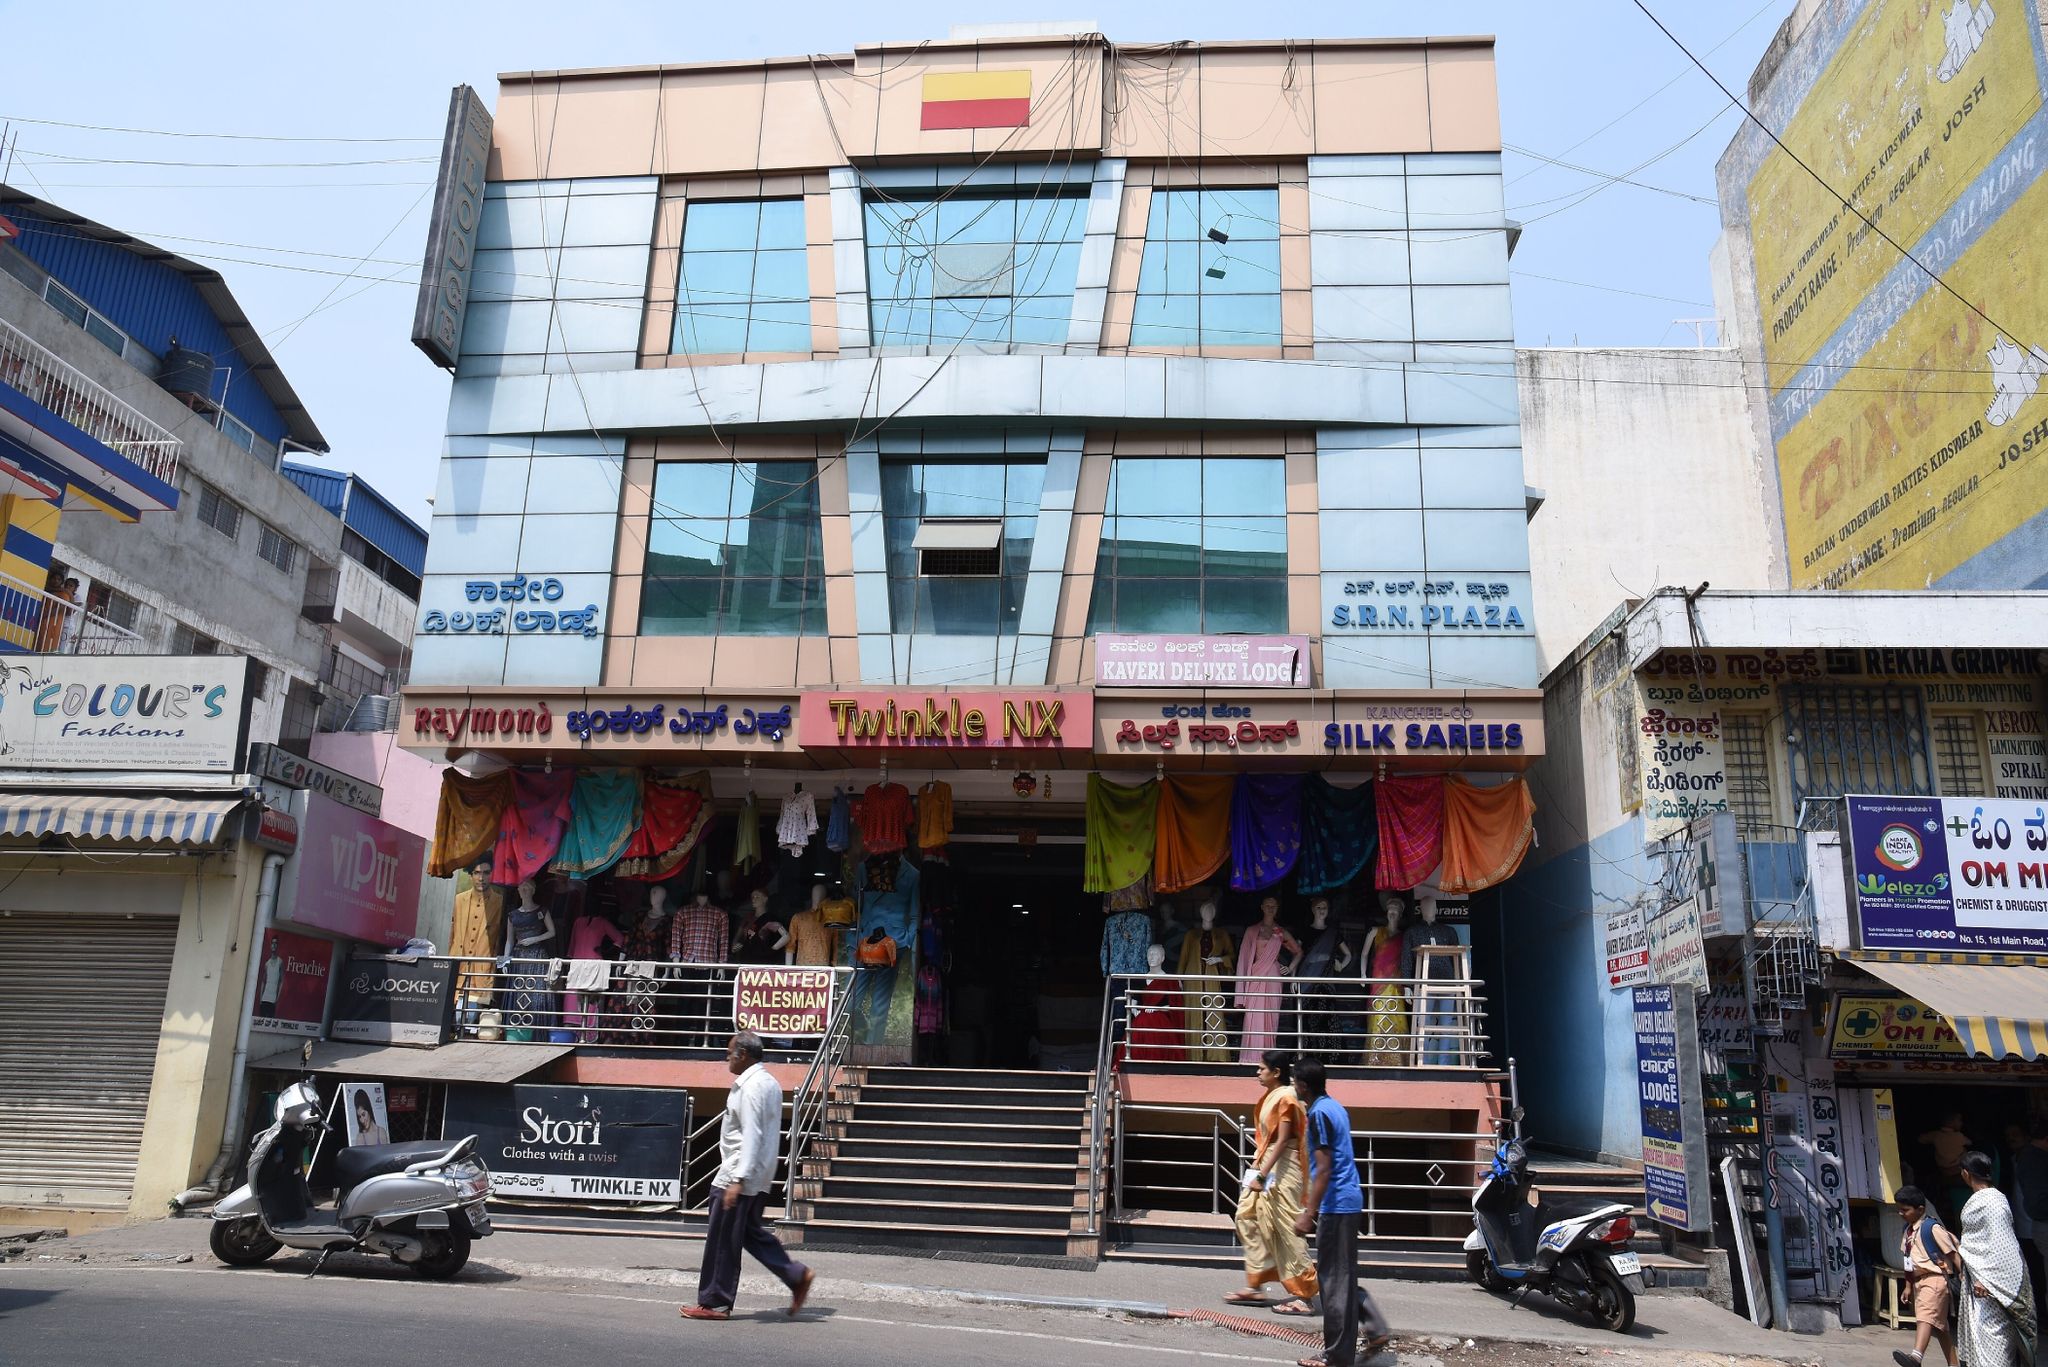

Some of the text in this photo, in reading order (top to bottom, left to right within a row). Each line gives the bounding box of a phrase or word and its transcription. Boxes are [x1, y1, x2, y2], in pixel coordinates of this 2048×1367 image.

[1797, 214, 1840, 272] UNDERWEAR
[1841, 165, 1877, 216] PANTIES
[1877, 107, 1924, 170] KIDSWEAR
[1773, 285, 1809, 343] PRODUCT
[1888, 148, 1932, 207] REGULAR
[1942, 76, 1987, 142] JOSH
[1783, 366, 1824, 422] TRIED
[1803, 420, 1984, 569] BANIAN UNDERWEAR PANTIES KIDSWEAR
[1891, 509, 1937, 550] Premium
[1942, 475, 1979, 513] REGULAR
[1998, 418, 2048, 470] JOSH
[465, 575, 564, 601] ಕಾವೇರಿ
[423, 607, 506, 635] ಡಿಲಕ್ಸ್
[1332, 604, 1525, 628] S.R.N. PLAZA
[1109, 640, 1157, 653] ಕಾವೇರಿ
[1102, 661, 1165, 681] KAVERI
[1170, 661, 1237, 681] DELUXE
[1865, 650, 1948, 675] REKHA
[20, 675, 54, 696] New
[1925, 684, 2033, 703] BLUE PRINTING
[414, 701, 552, 741] Raymond
[669, 703, 728, 735] ಎನ್
[733, 704, 792, 742] ಎಕ್ಸ್
[829, 698, 1063, 738] Twinkle NX
[1366, 706, 1474, 720] KANCHEE-CO
[1984, 710, 2042, 733] XEROX
[61, 721, 185, 738] Fashions
[1116, 719, 1180, 749] ಸಿಲ್ಕ್
[1324, 723, 1523, 748] SILK SAREES
[1989, 739, 2047, 755] LAMINATION
[1971, 806, 2012, 850] ಓಂ
[1886, 842, 1914, 850] INDIA
[331, 831, 399, 904] VIPUL
[1961, 860, 2009, 889] OM
[1858, 873, 1937, 895] Welezo
[1895, 896, 1917, 904] Health
[1956, 898, 2048, 913] CHEMIST & DRUGGIST
[1959, 935, 1974, 944] No.
[1989, 936, 2001, 945] 1st
[2002, 937, 2021, 945] Main
[1665, 937, 1700, 970] MEDICALS
[286, 955, 326, 978] Frenchie
[1621, 970, 1648, 982] RECEPTION
[372, 978, 441, 994] JOCKEY
[741, 971, 830, 988] WANTED
[740, 990, 827, 1008] SALESMAN
[738, 1012, 826, 1032] SALESGIRL
[1884, 1025, 1925, 1042] OM
[1836, 1041, 1873, 1050] CHEMIST
[1896, 1043, 1940, 1051] DRUGGIST
[1642, 1082, 1678, 1103] LODGE
[502, 1146, 618, 1163] Clothes with a twist
[649, 1181, 672, 1197] NX
